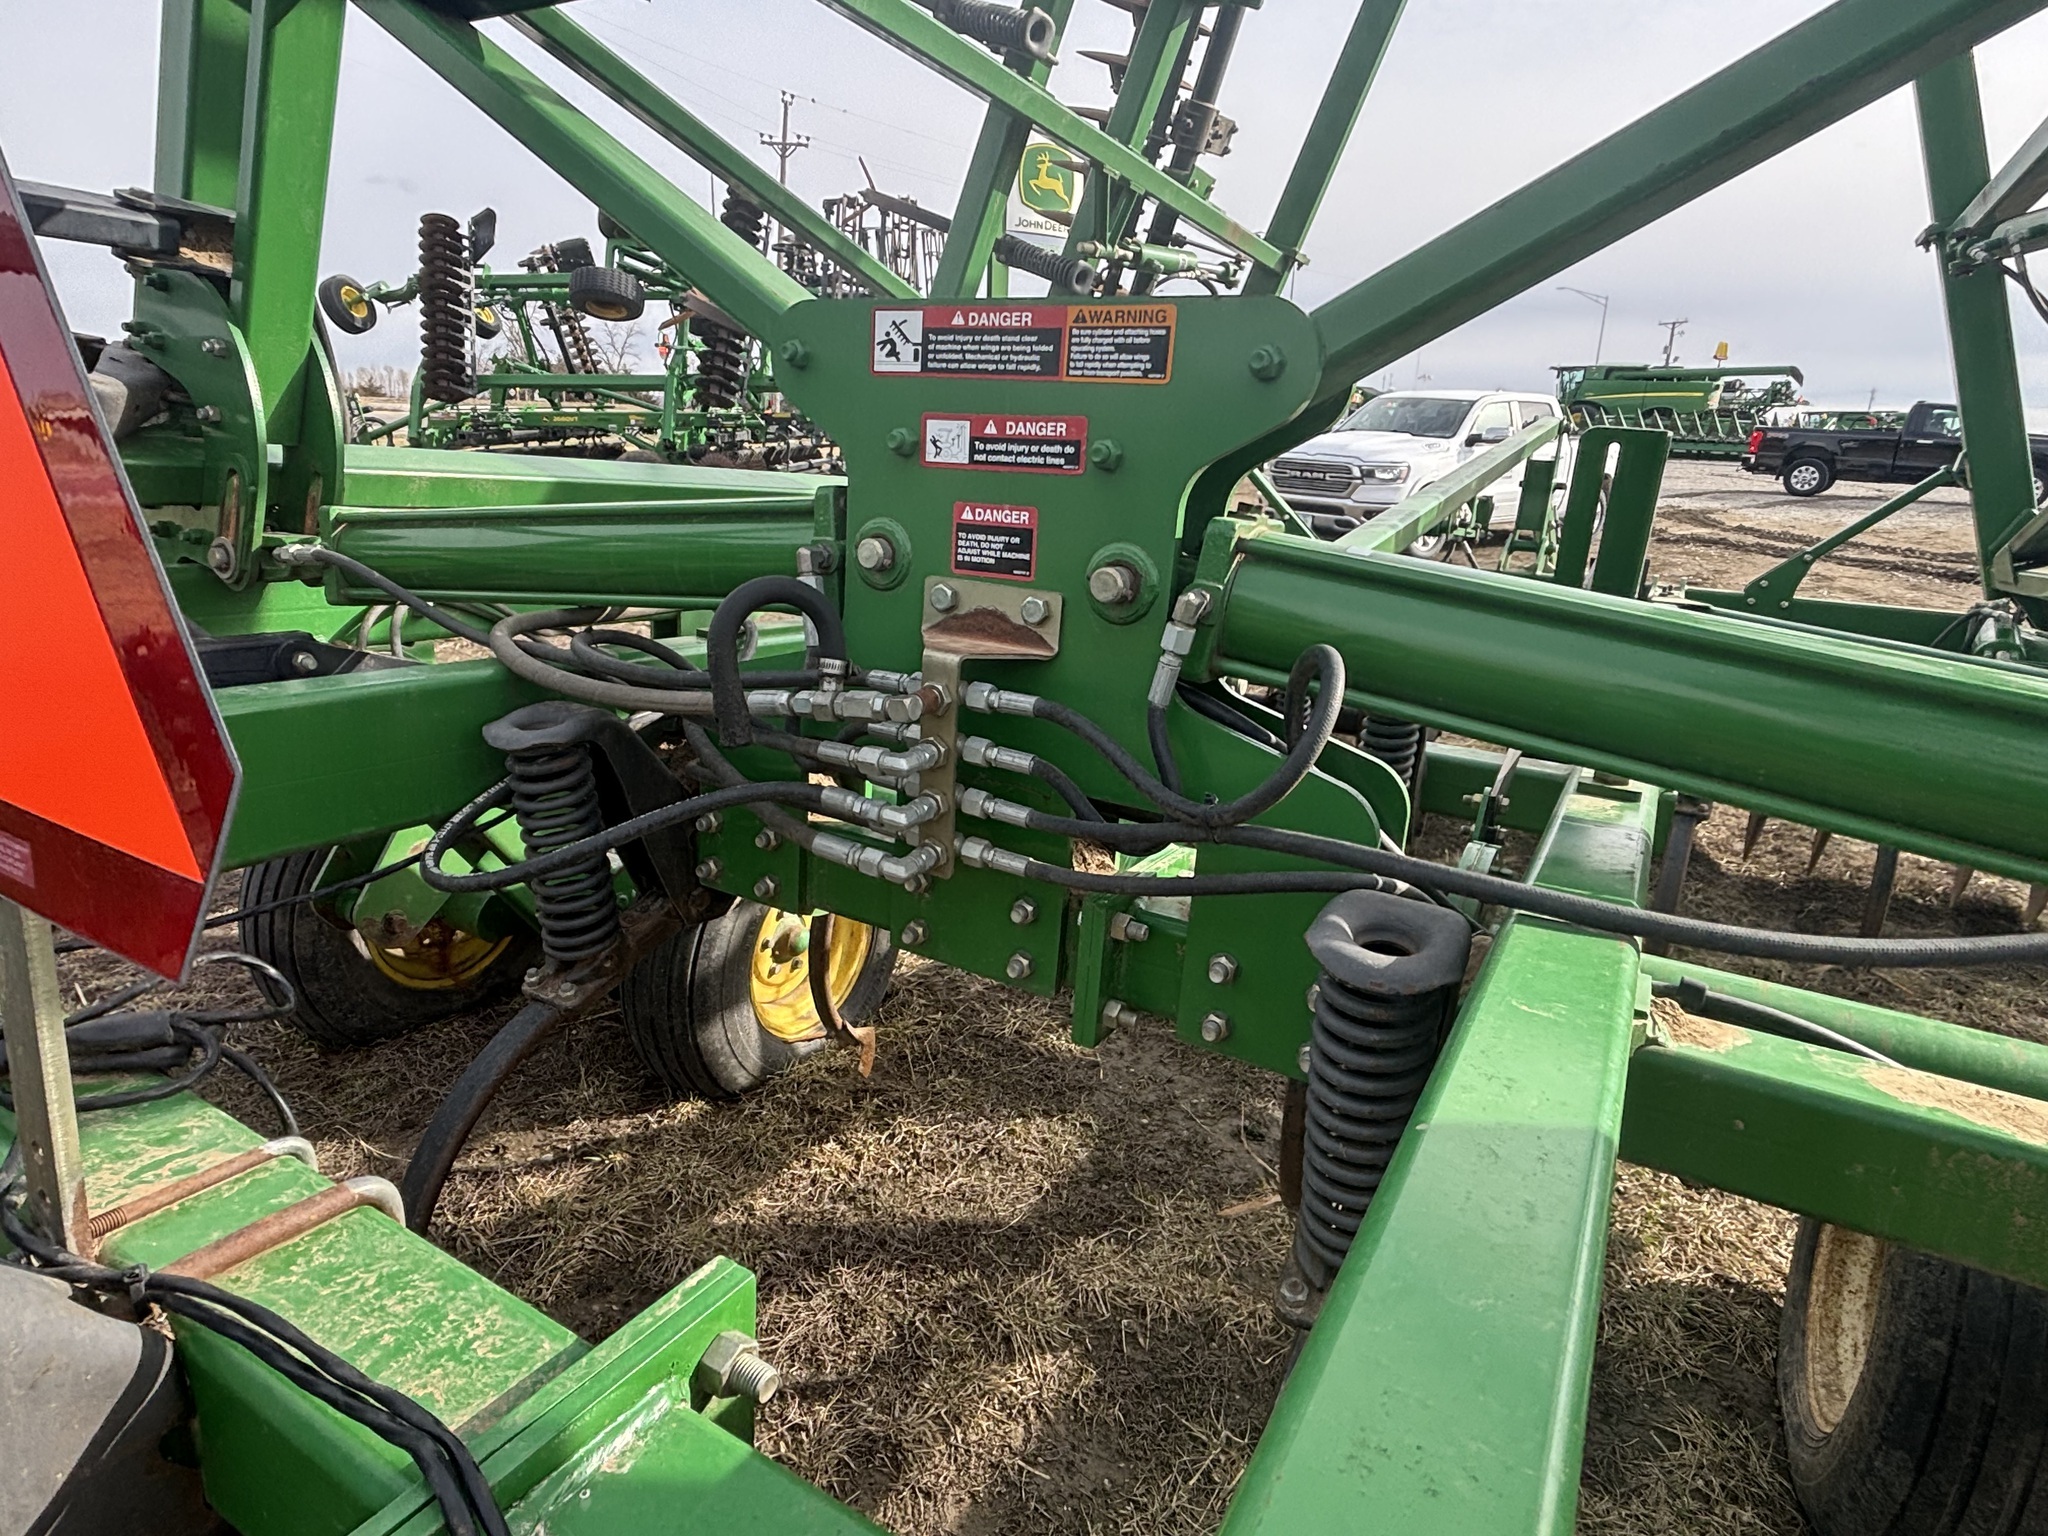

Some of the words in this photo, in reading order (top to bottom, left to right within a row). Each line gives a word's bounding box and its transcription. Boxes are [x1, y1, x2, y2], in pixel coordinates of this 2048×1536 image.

[1014, 216, 1043, 230] JOHN
[968, 311, 1033, 327] DANGER
[1088, 309, 1168, 323] WARNING
[928, 333, 936, 341] To
[955, 334, 973, 343] injury
[982, 334, 1000, 342] death
[980, 344, 999, 353] wings
[1012, 345, 1031, 353] being
[1032, 344, 1054, 352] folded
[1009, 354, 1041, 362] hydraulic
[977, 362, 997, 371] wings
[1005, 421, 1067, 437] DANGER
[974, 441, 985, 451] To
[985, 442, 1006, 452] avoid
[1007, 443, 1030, 454] injury
[1030, 445, 1040, 453] or
[1040, 444, 1063, 454] death
[1063, 445, 1075, 454] do
[973, 453, 986, 462] not
[987, 454, 1016, 463] contact
[1016, 455, 1045, 464] electric
[975, 507, 1030, 525] DANGER
[967, 533, 986, 541] AVOID
[987, 534, 1010, 543] INJURY
[957, 547, 981, 555] ADJUST
[981, 549, 1001, 558] WHILE
[1001, 551, 1031, 561] MACHINE
